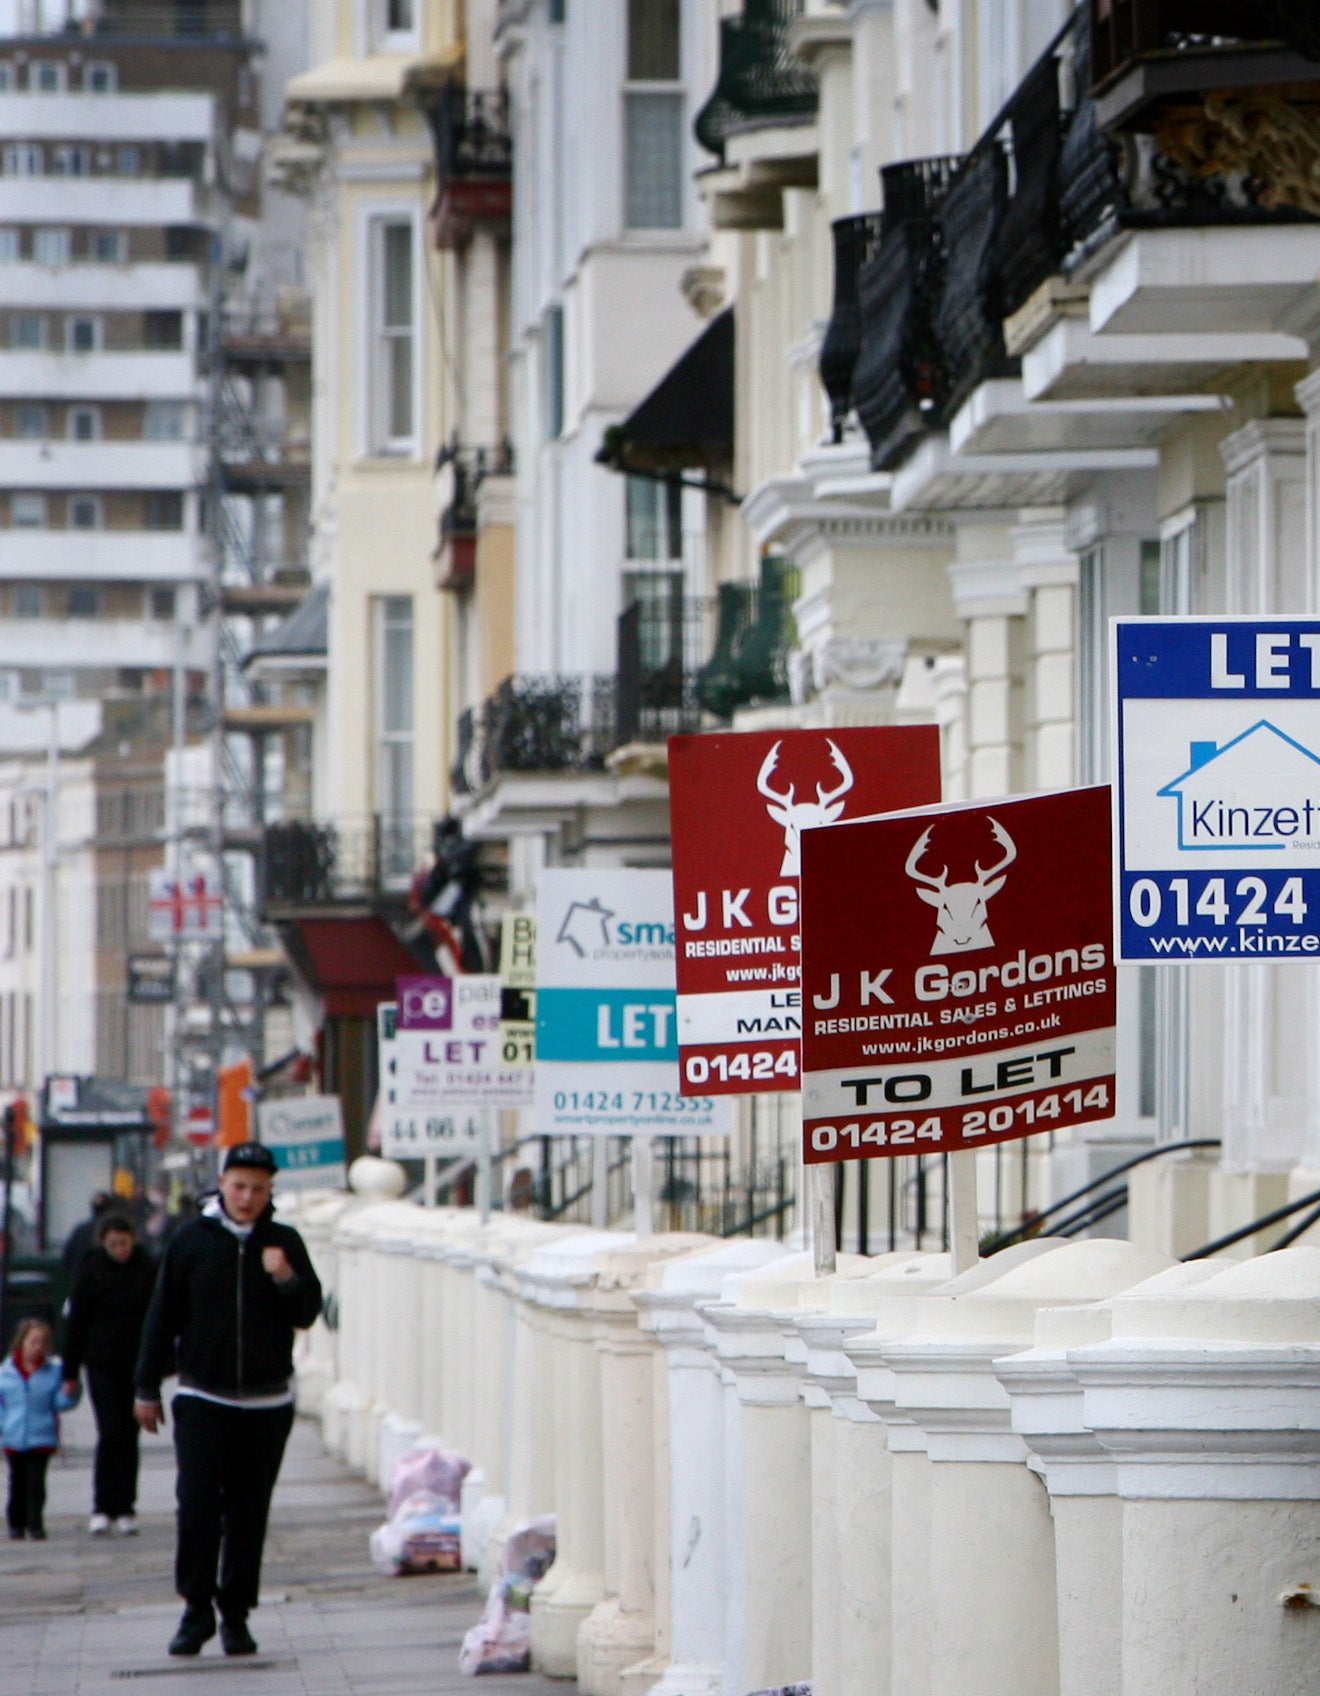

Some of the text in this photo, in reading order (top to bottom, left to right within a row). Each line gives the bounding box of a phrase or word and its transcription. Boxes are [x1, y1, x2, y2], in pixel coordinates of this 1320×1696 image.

[682, 891, 707, 932] J
[722, 888, 753, 929] K
[1128, 875, 1308, 929] 01424
[684, 935, 787, 959] RESIDENTIAL
[812, 942, 1106, 1011] J K Gordons
[596, 1003, 673, 1049] LET
[813, 978, 1107, 1036] RESIDENTIAL SALES & LETTINGS
[423, 1040, 489, 1065] LET
[861, 1013, 1062, 1056] www.jkgordons.co.uk
[685, 1049, 798, 1083] 01424
[840, 1046, 1076, 1107] TO LET
[553, 1090, 623, 1111] 01424
[632, 1090, 716, 1113] 712555
[810, 1083, 1110, 1153] 01424 201414
